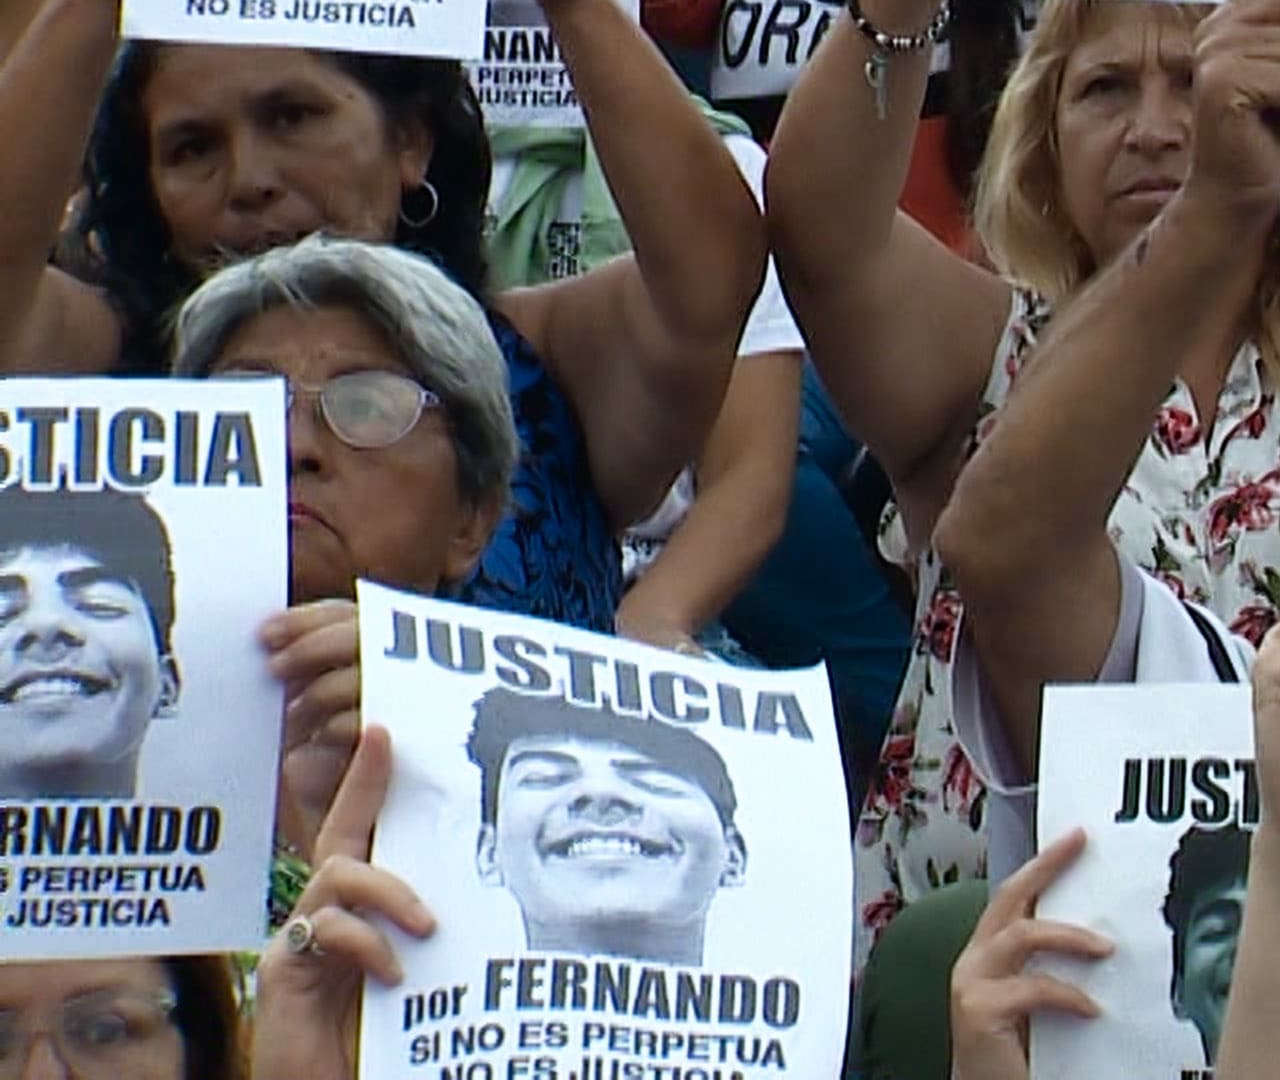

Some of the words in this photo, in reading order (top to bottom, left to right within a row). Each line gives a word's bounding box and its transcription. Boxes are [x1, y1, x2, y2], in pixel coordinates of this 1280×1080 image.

[478, 66, 569, 87] PERPET
[0, 407, 262, 487] TICIA
[383, 608, 814, 743] JUSTICIA
[1114, 757, 1258, 825] JUST
[0, 806, 223, 857] RNANDO
[20, 866, 206, 892] PERPETUA
[7, 898, 171, 928] JUSTICIA
[402, 983, 469, 1031] por
[484, 957, 801, 1030] FERNANDO
[409, 1031, 441, 1065] SI
[450, 1021, 506, 1058] NO
[518, 1021, 569, 1050] ES
[582, 1022, 788, 1070] PERPETUA
[440, 1058, 493, 1080] NO
[507, 1056, 559, 1080] ES
